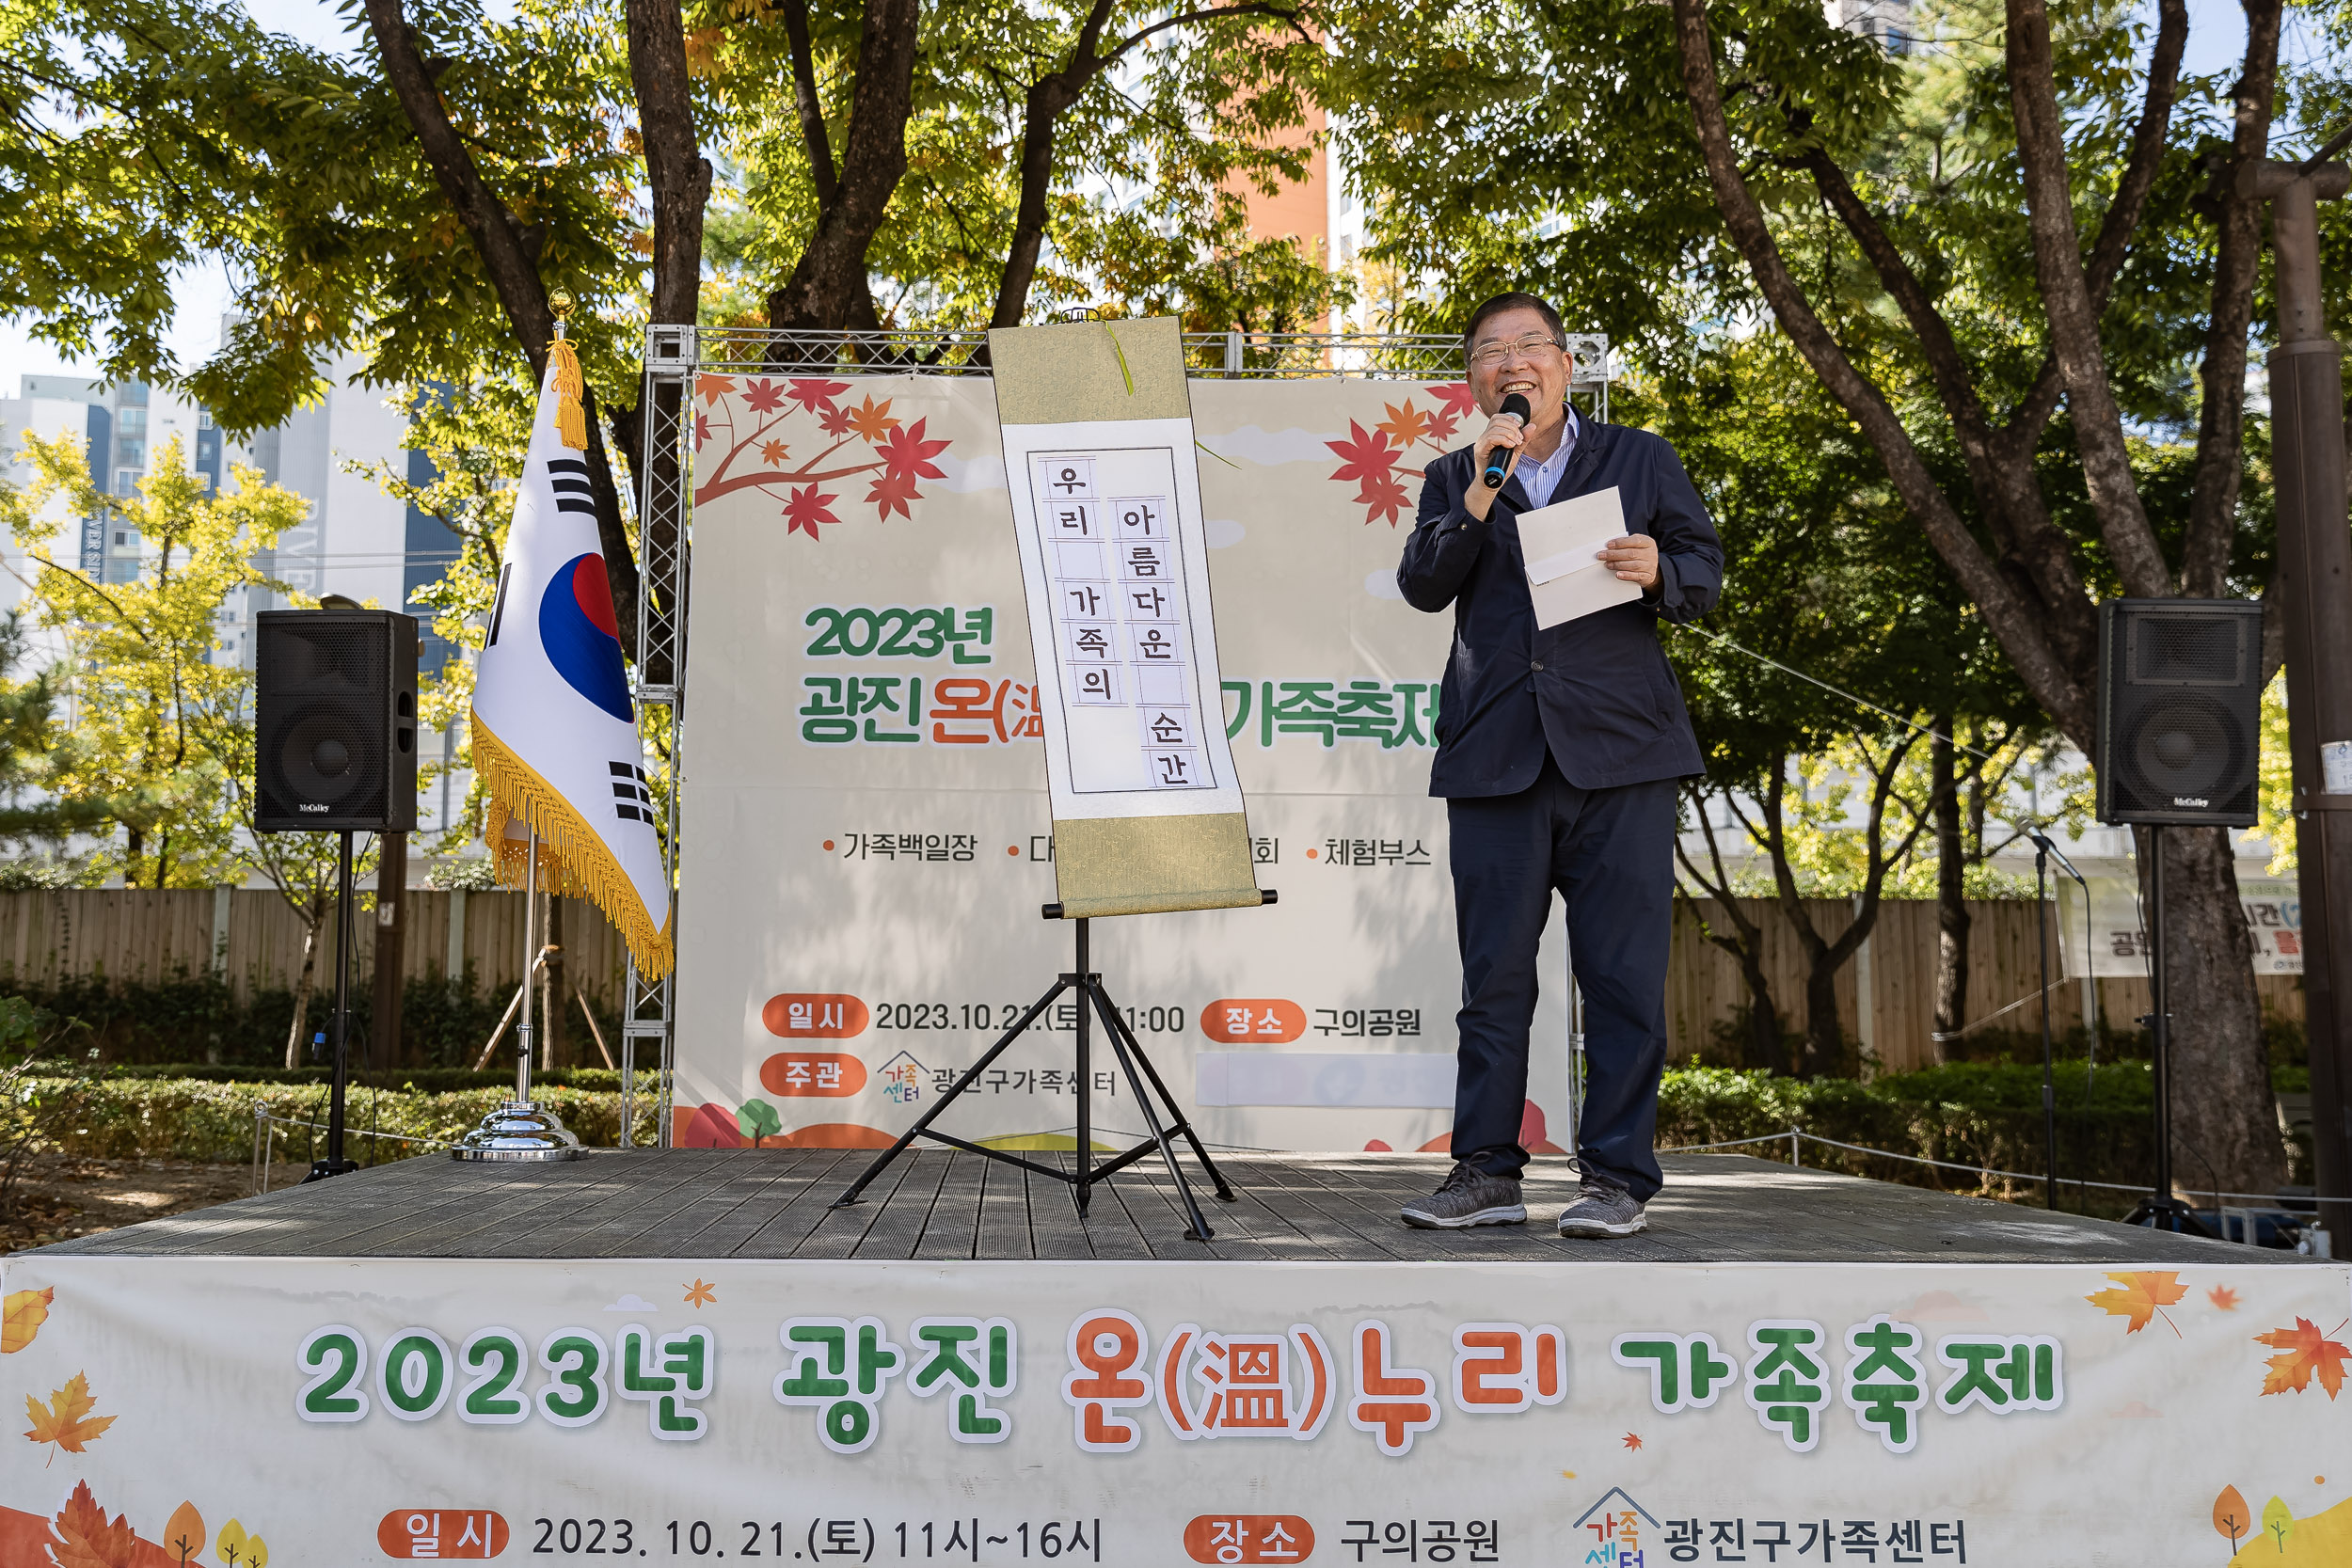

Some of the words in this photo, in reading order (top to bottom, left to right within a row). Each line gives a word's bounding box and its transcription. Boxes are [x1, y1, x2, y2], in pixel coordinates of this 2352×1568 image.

[1053, 467, 1089, 536] 우리
[805, 607, 993, 665] 2023년
[1070, 586, 1112, 701] 가족의
[1123, 504, 1172, 659] 아름다운
[1150, 711, 1188, 785] 순간
[800, 676, 921, 743] 광진
[843, 832, 978, 862] 가족백일장
[1325, 837, 1431, 866] 체험부스
[788, 1002, 844, 1030] 일시
[1226, 1007, 1282, 1035] 장소
[1313, 1008, 1421, 1037] 구의공원
[786, 1061, 844, 1089] 주관
[303, 1330, 706, 1433] 2023년
[781, 1324, 1006, 1445] 광진
[1620, 1322, 2054, 1445] 가족축제
[532, 1516, 645, 1555] 2023.
[664, 1516, 724, 1557] 10.
[1341, 1519, 1499, 1562] 구의공원
[1663, 1518, 1967, 1563] 광진구가족센터
